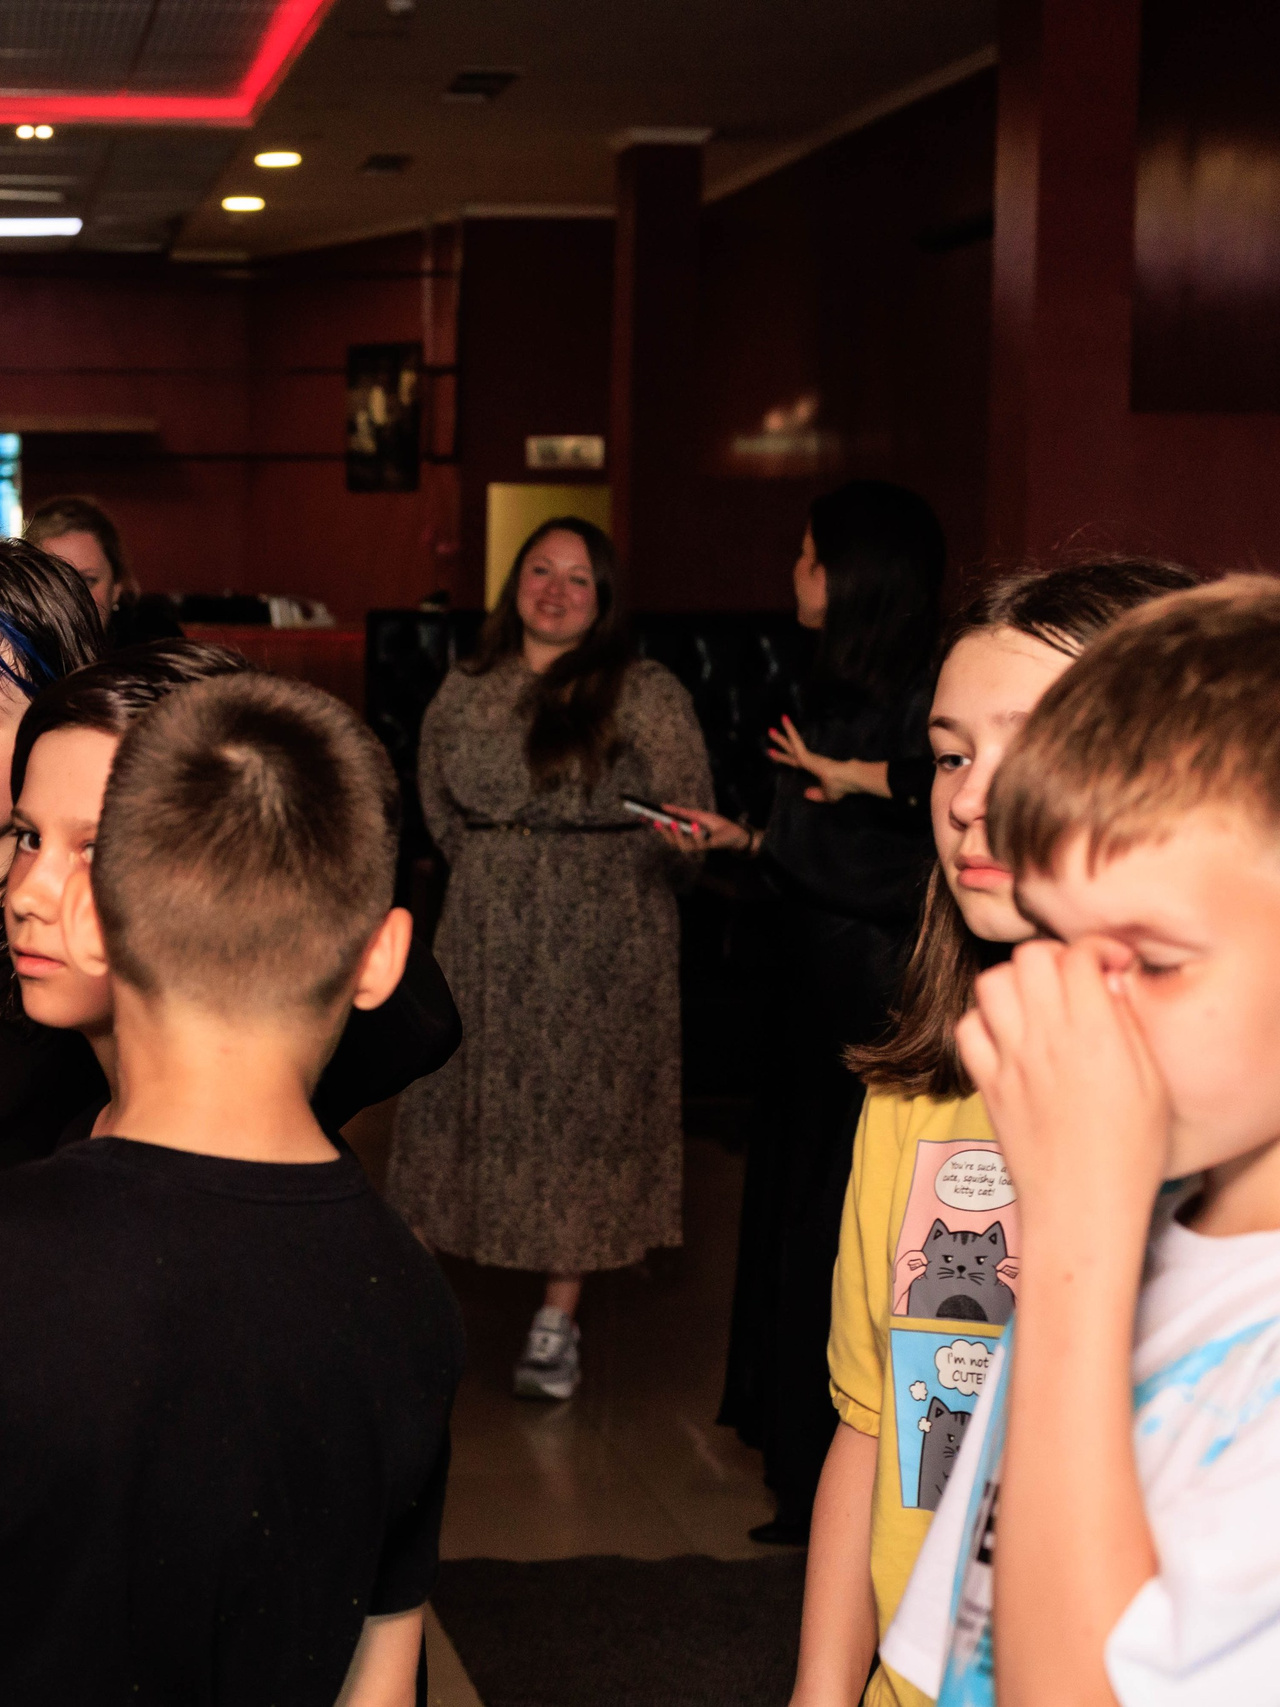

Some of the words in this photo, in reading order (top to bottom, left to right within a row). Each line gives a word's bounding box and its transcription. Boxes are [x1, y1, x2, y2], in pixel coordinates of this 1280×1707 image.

[950, 1161, 975, 1171] You're
[977, 1162, 997, 1172] such
[963, 1173, 995, 1187] squishy
[953, 1184, 975, 1197] kitty
[977, 1187, 996, 1197] cat!
[947, 1352, 966, 1366] I'm
[969, 1356, 990, 1369] not
